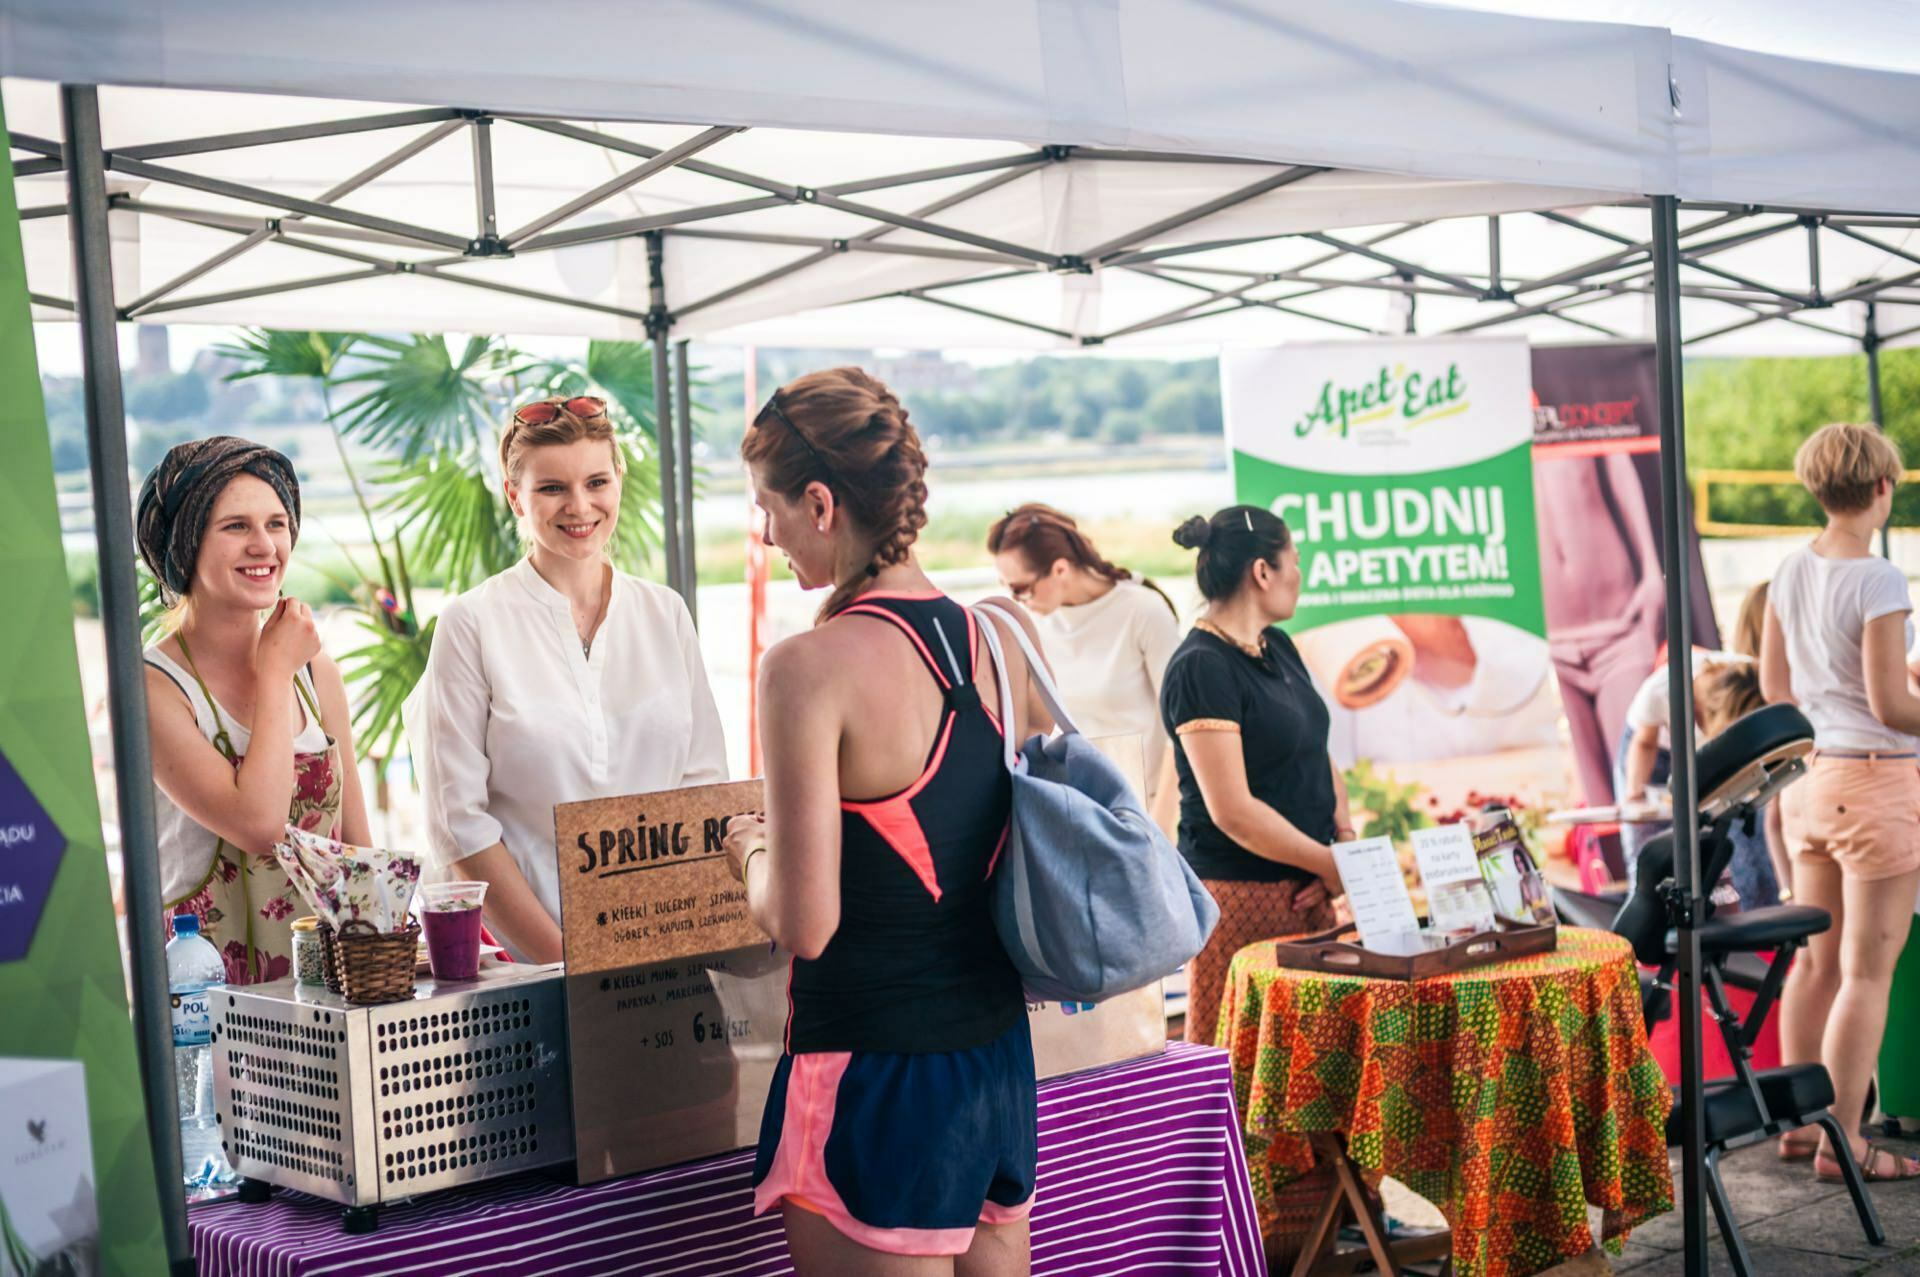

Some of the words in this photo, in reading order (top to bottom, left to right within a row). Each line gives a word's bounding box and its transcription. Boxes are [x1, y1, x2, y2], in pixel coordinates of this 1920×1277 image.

[1269, 486, 1507, 544] CHUDNIJ
[1307, 543, 1510, 589] APETYTEM!
[0, 886, 24, 905] IA
[660, 918, 694, 935] KAPUSTA
[655, 1030, 675, 1049] SOS
[693, 1011, 706, 1044] 6
